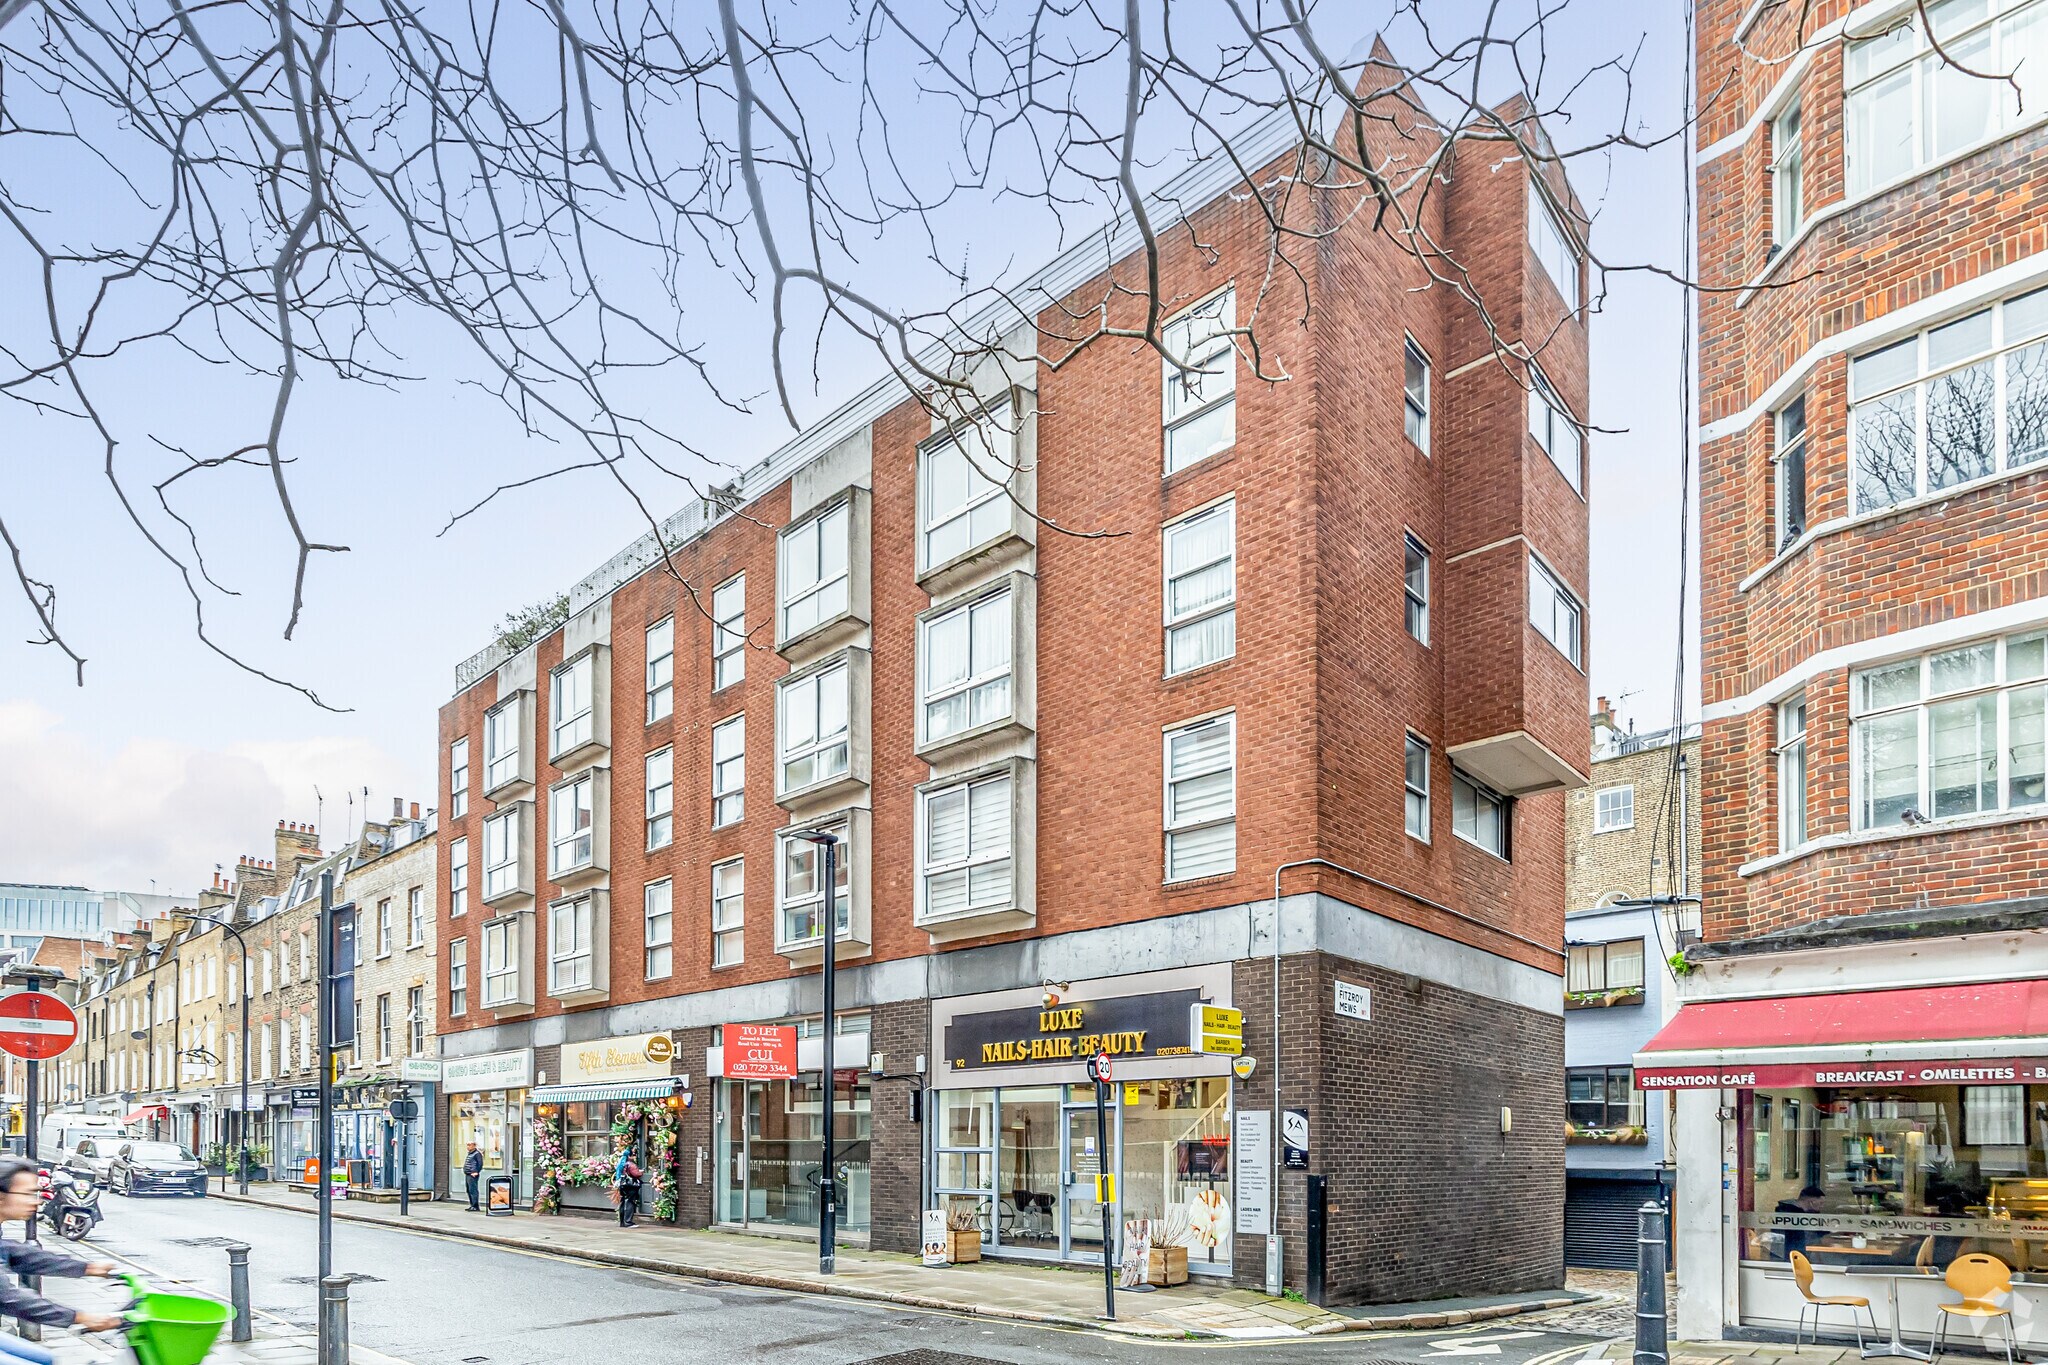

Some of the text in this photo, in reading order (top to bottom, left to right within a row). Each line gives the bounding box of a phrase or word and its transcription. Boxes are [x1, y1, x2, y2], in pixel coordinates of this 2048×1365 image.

[1339, 990, 1364, 1004] FITZROY
[1339, 1002, 1357, 1014] MEWS
[1039, 1008, 1082, 1032] LUXE
[1216, 1013, 1229, 1022] LUXE
[742, 1026, 779, 1036] TO LET
[653, 1043, 667, 1051] Fifth
[748, 1049, 773, 1061] CUI
[469, 1060, 491, 1075] HEALTH
[498, 1057, 523, 1073] BEAUTY
[579, 1051, 602, 1075] Fifth
[956, 1058, 966, 1068] 92
[1099, 1061, 1110, 1074] 20
[1642, 1075, 1718, 1087] SENSATION
[1721, 1072, 1756, 1085] CAFÉ
[1815, 1070, 1905, 1083] BREAKFAST
[1920, 1067, 2015, 1081] OMELETTES
[1758, 1215, 1841, 1227] CAPPUCCINO
[1860, 1218, 1952, 1232] SANDWICHES
